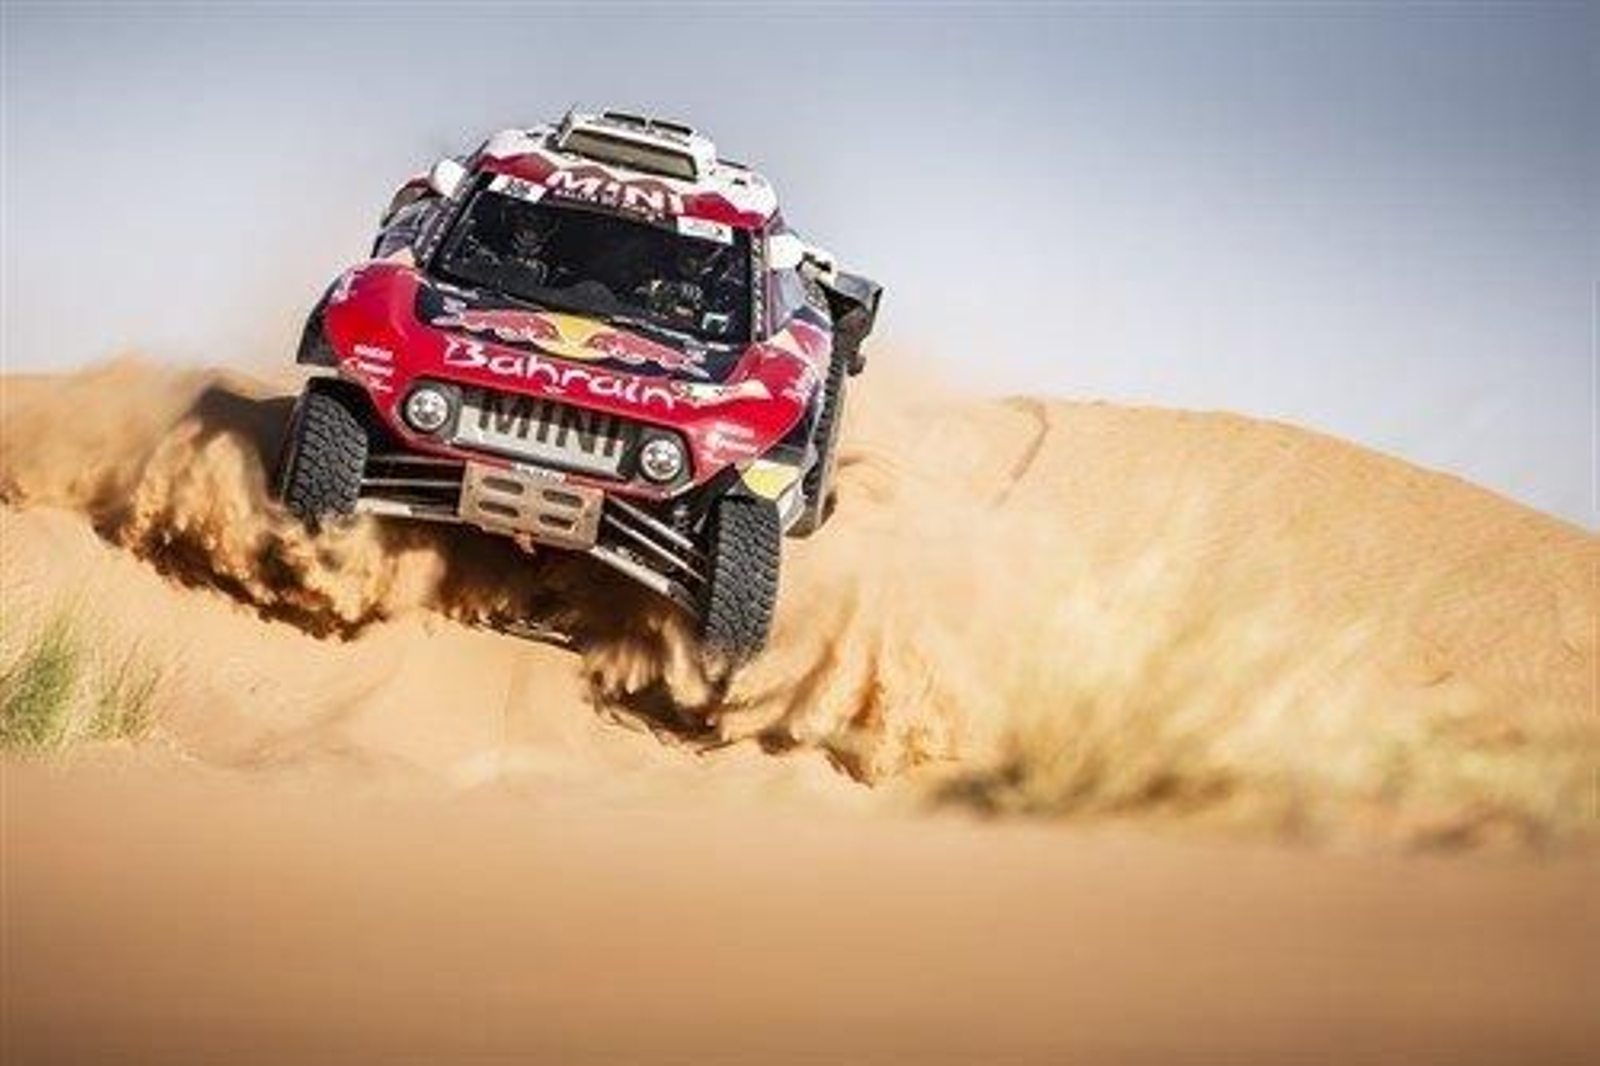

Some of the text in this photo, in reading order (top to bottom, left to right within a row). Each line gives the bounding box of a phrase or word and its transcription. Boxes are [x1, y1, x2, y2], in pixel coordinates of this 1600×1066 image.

[545, 170, 685, 214] MINI
[443, 335, 675, 410] Bahrain
[478, 394, 621, 458] MINI
